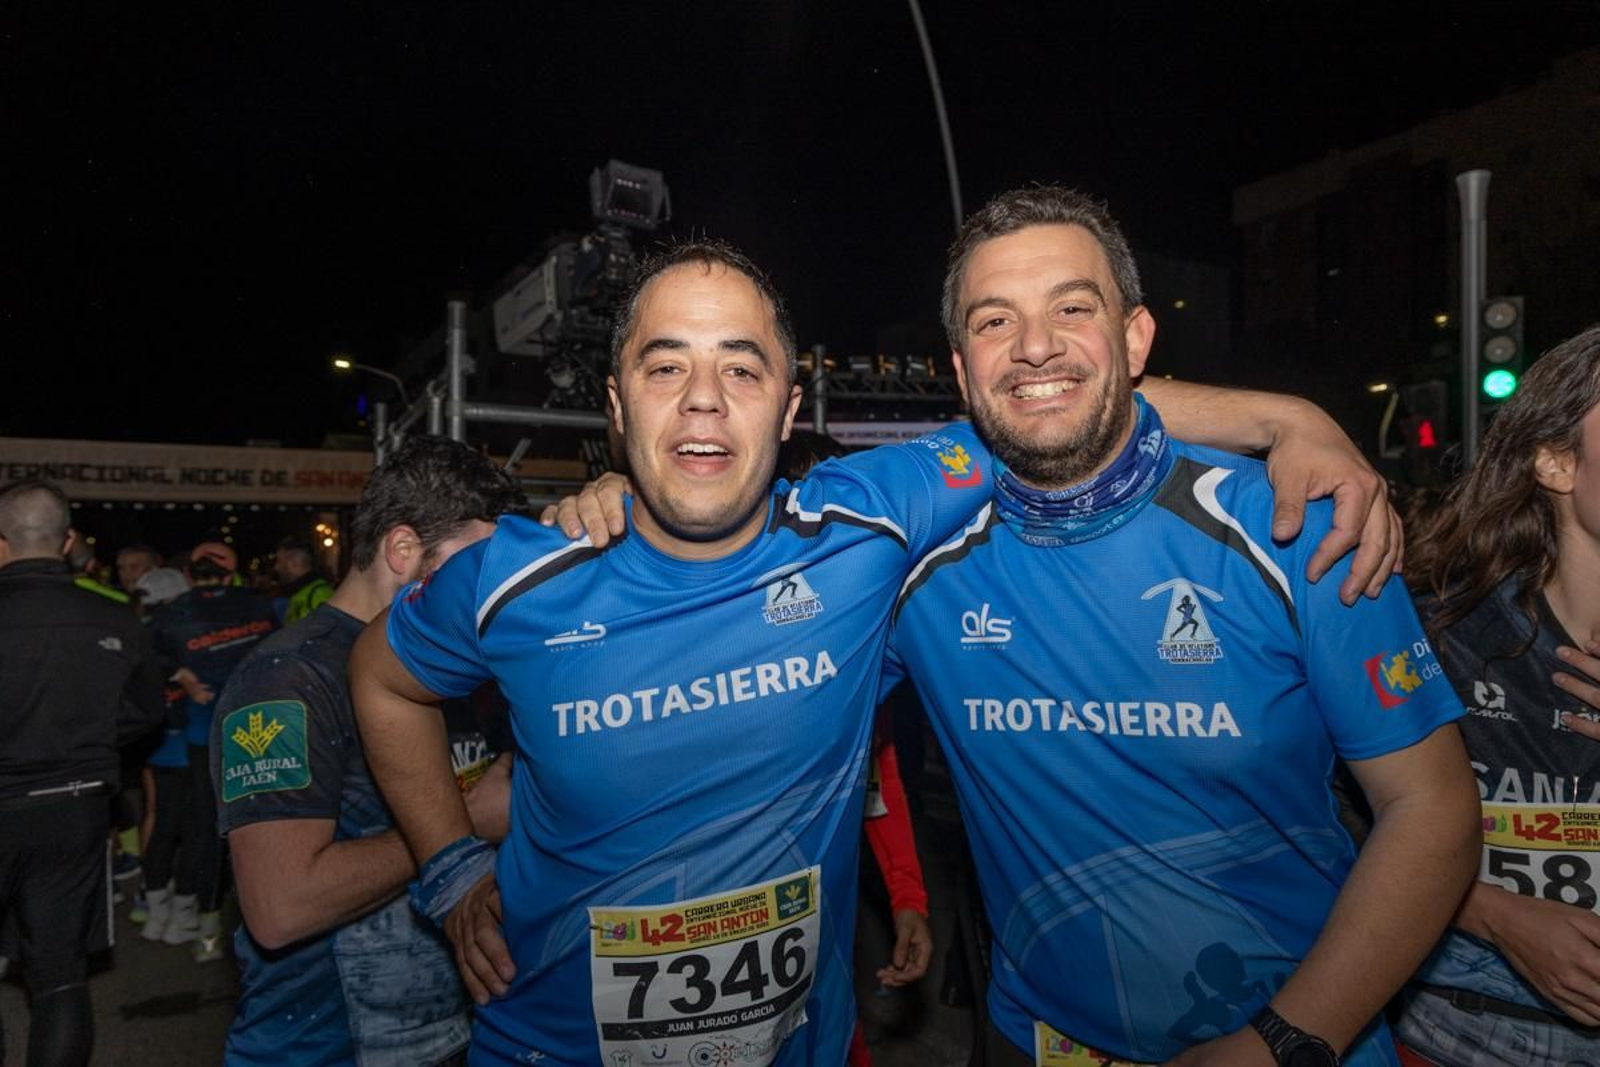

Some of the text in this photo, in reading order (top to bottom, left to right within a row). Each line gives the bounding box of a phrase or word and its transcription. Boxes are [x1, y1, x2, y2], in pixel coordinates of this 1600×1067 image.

[181, 467, 253, 487] NOCHE
[260, 469, 288, 487] DE
[294, 469, 334, 488] SAN
[552, 650, 838, 737] TROTASIERRA
[963, 698, 1242, 738] TROTASIERRA
[255, 757, 302, 773] RURAL
[1513, 812, 1562, 841] 42
[1564, 828, 1599, 841] SAN
[685, 901, 729, 918] CARRERA
[731, 891, 767, 908] URBANA
[640, 913, 686, 946] 42
[686, 907, 769, 940] SAN ANTON
[612, 926, 806, 1020] 7346
[667, 1003, 776, 1033] JUAN JURADO GARCIA
